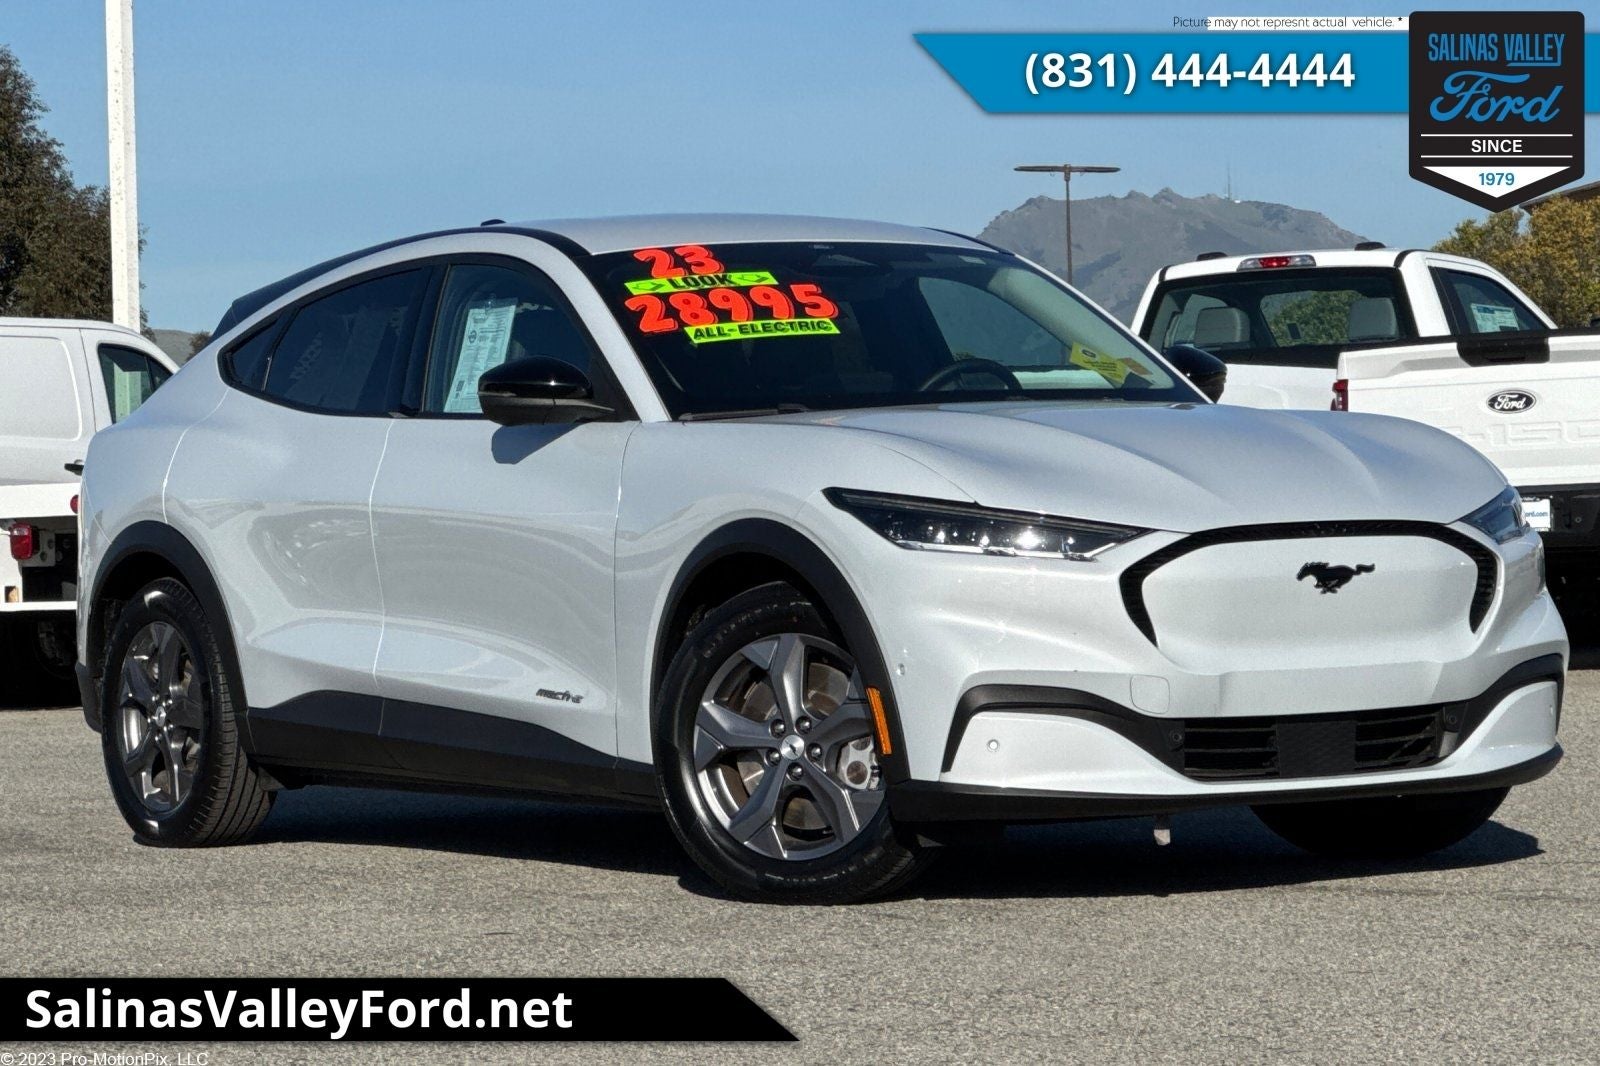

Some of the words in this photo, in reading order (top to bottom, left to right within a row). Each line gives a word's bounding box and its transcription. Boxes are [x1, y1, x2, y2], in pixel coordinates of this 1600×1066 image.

[633, 244, 725, 278] 23
[666, 273, 734, 291] LOOK
[624, 283, 840, 334] 28995
[692, 320, 833, 339] ALL-ELECTRIC
[1494, 393, 1526, 411] Ford
